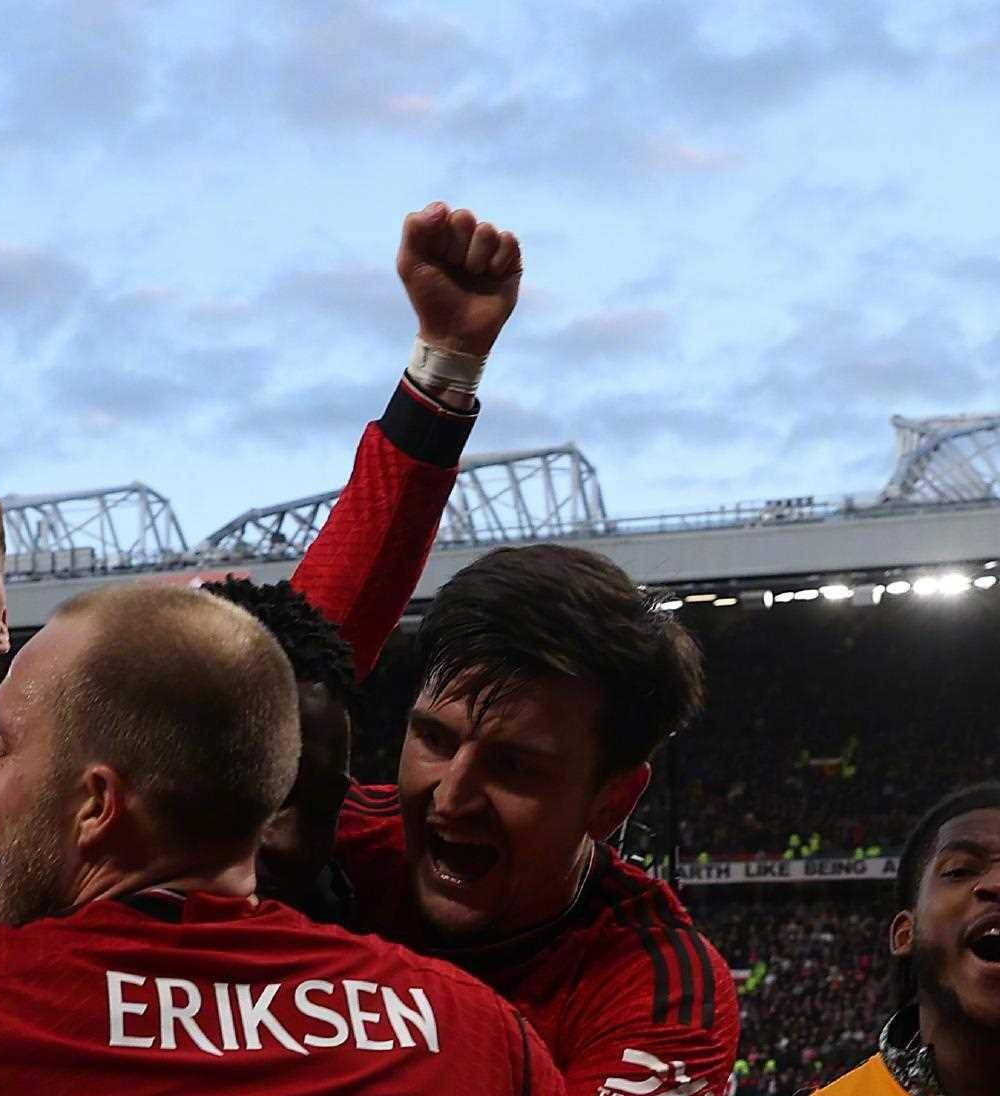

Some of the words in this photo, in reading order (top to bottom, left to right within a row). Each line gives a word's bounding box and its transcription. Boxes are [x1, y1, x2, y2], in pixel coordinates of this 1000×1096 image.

[669, 863, 732, 880] ARTH
[745, 861, 790, 877] LIKE
[805, 858, 867, 875] BEING
[105, 970, 440, 1055] ERIKSEN
